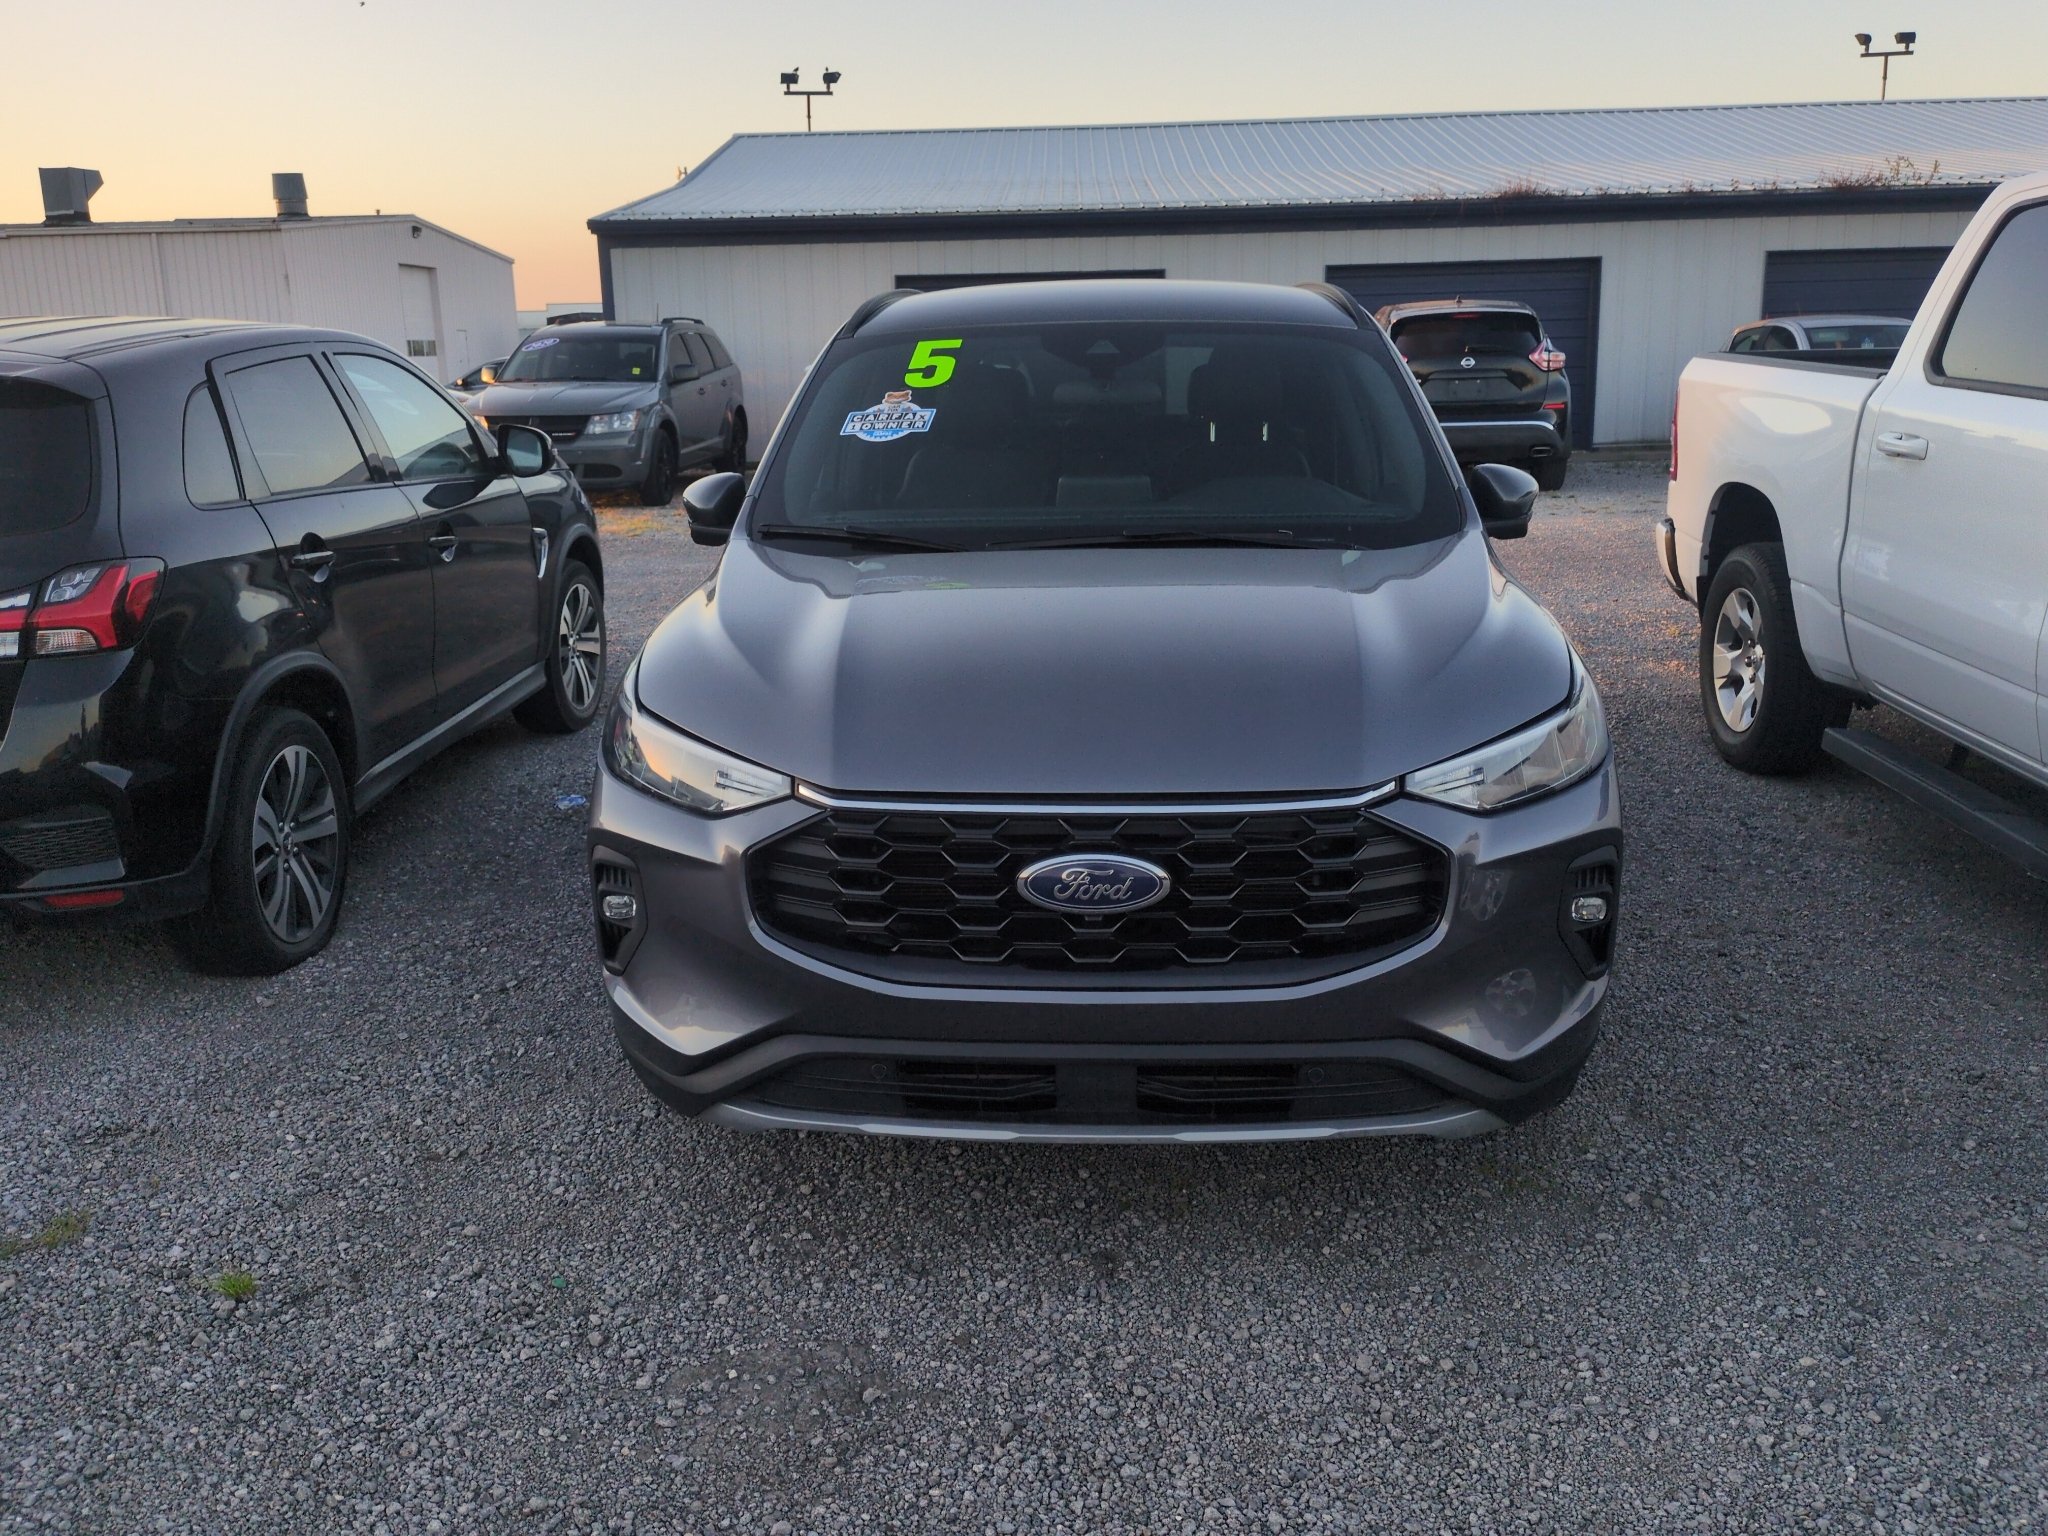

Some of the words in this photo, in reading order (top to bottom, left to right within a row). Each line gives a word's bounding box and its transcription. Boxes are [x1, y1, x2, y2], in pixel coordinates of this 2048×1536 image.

[904, 339, 963, 388] 5
[853, 413, 927, 422] CARFAX
[1053, 867, 1135, 900] Ford
